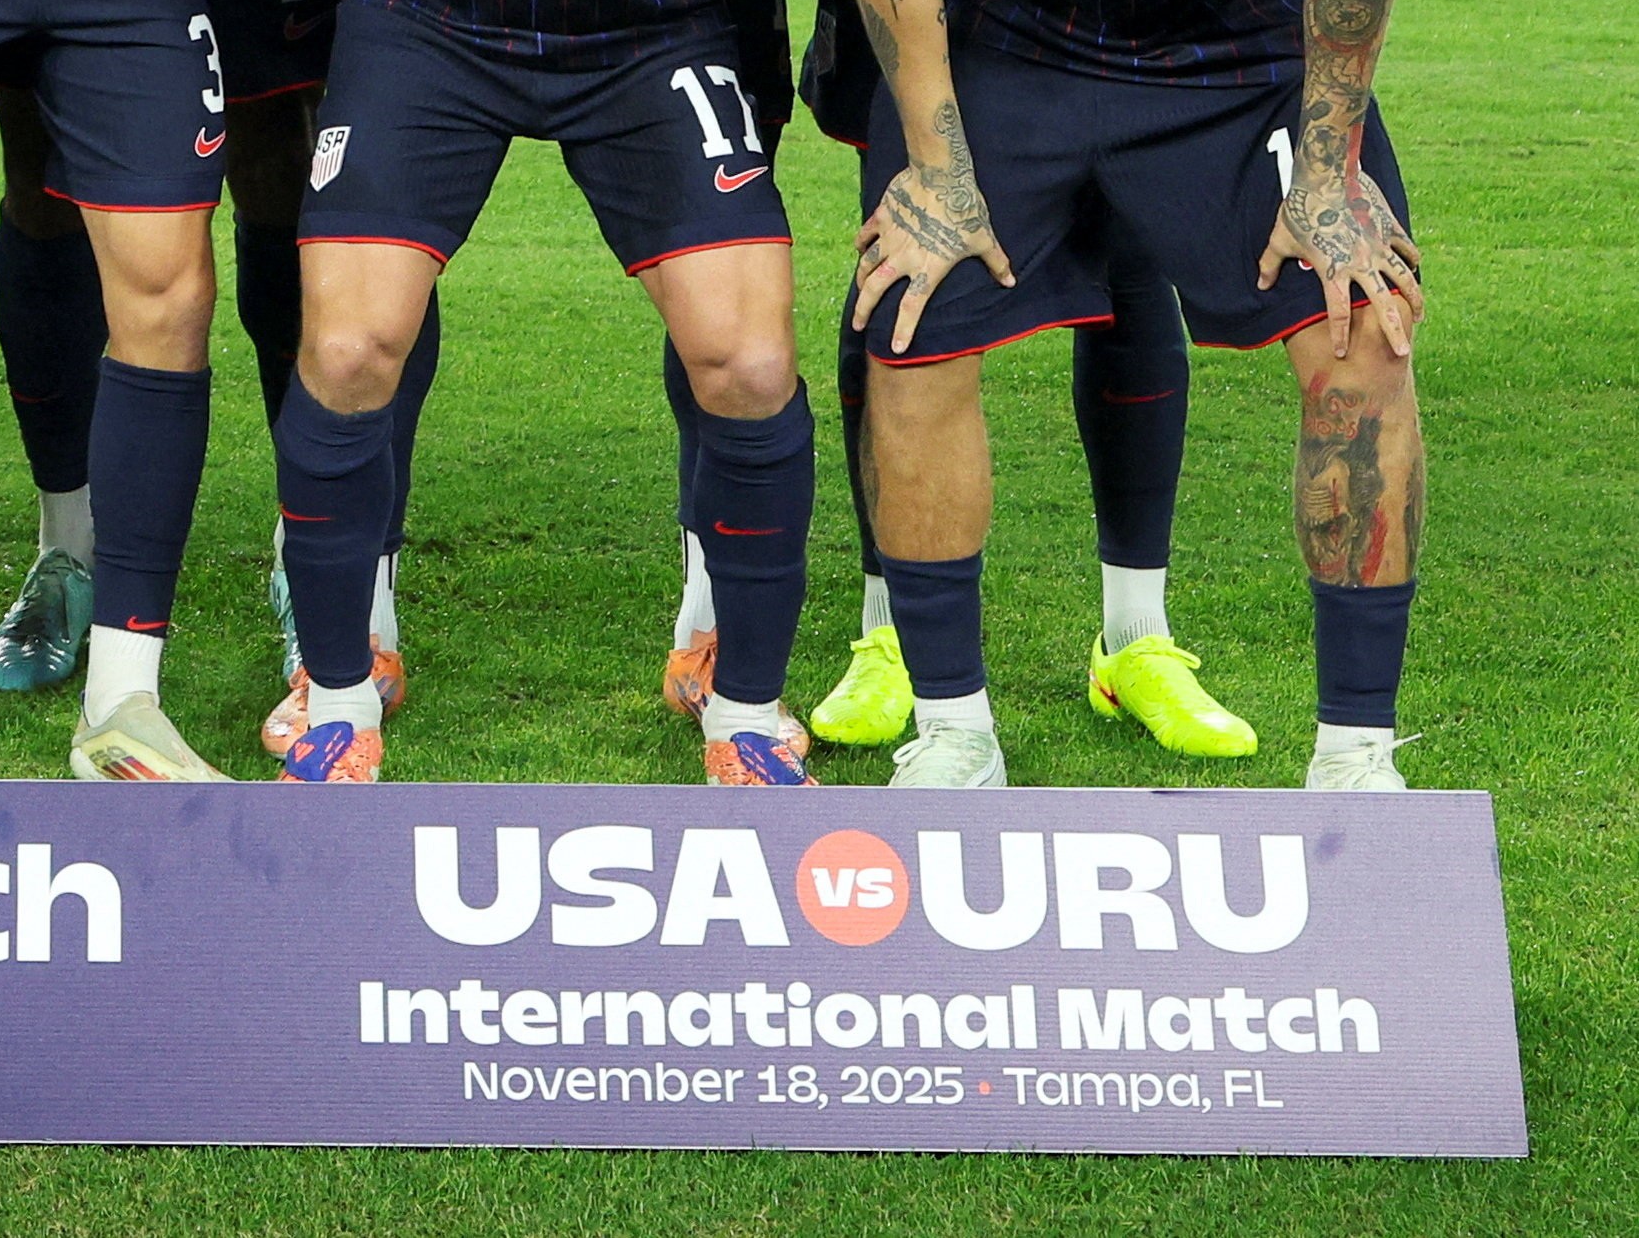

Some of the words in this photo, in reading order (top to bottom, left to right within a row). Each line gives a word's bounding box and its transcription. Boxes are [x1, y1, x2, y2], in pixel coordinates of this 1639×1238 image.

[187, 13, 225, 114] 3
[670, 64, 764, 160] 17
[414, 825, 791, 947] USA
[917, 830, 1309, 954] URU
[360, 979, 1038, 1050] International
[1057, 987, 1381, 1054] Match
[463, 1061, 744, 1103] November
[757, 1064, 829, 1110] 18,
[840, 1065, 965, 1105] 2025
[1002, 1067, 1212, 1114] Tampa,
[1223, 1069, 1284, 1108] FL
